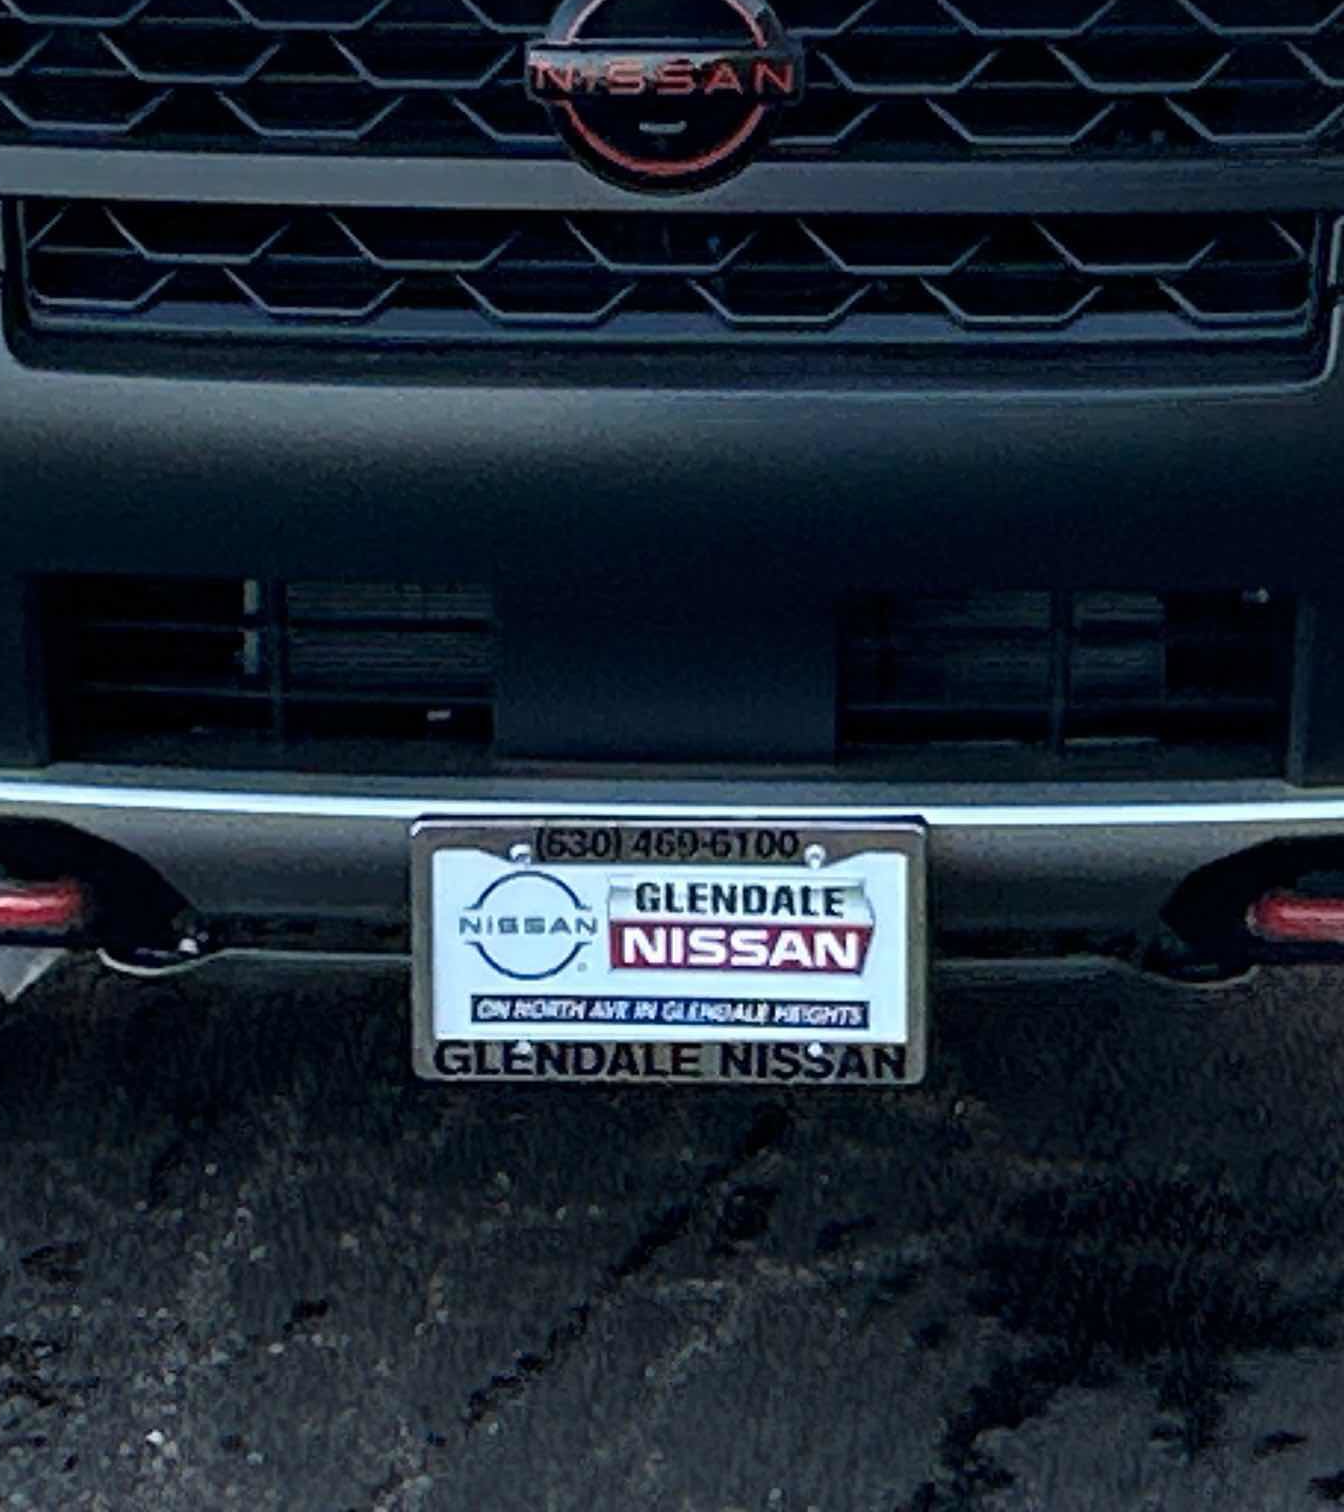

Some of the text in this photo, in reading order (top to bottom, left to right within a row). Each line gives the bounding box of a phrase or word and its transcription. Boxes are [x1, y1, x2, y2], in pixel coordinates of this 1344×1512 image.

[535, 60, 794, 96] NISSAN
[535, 826, 800, 862] (630) 469-6100
[635, 882, 846, 919] GLENDALE
[458, 915, 598, 935] NISSAN
[623, 925, 858, 968] NISSAN
[476, 998, 510, 1020] ON
[512, 998, 587, 1021] NORTH
[661, 1000, 769, 1025] GLENDALE
[773, 1003, 863, 1027] HEIGHTS
[432, 1039, 908, 1080] GLENDALE NISSAN
